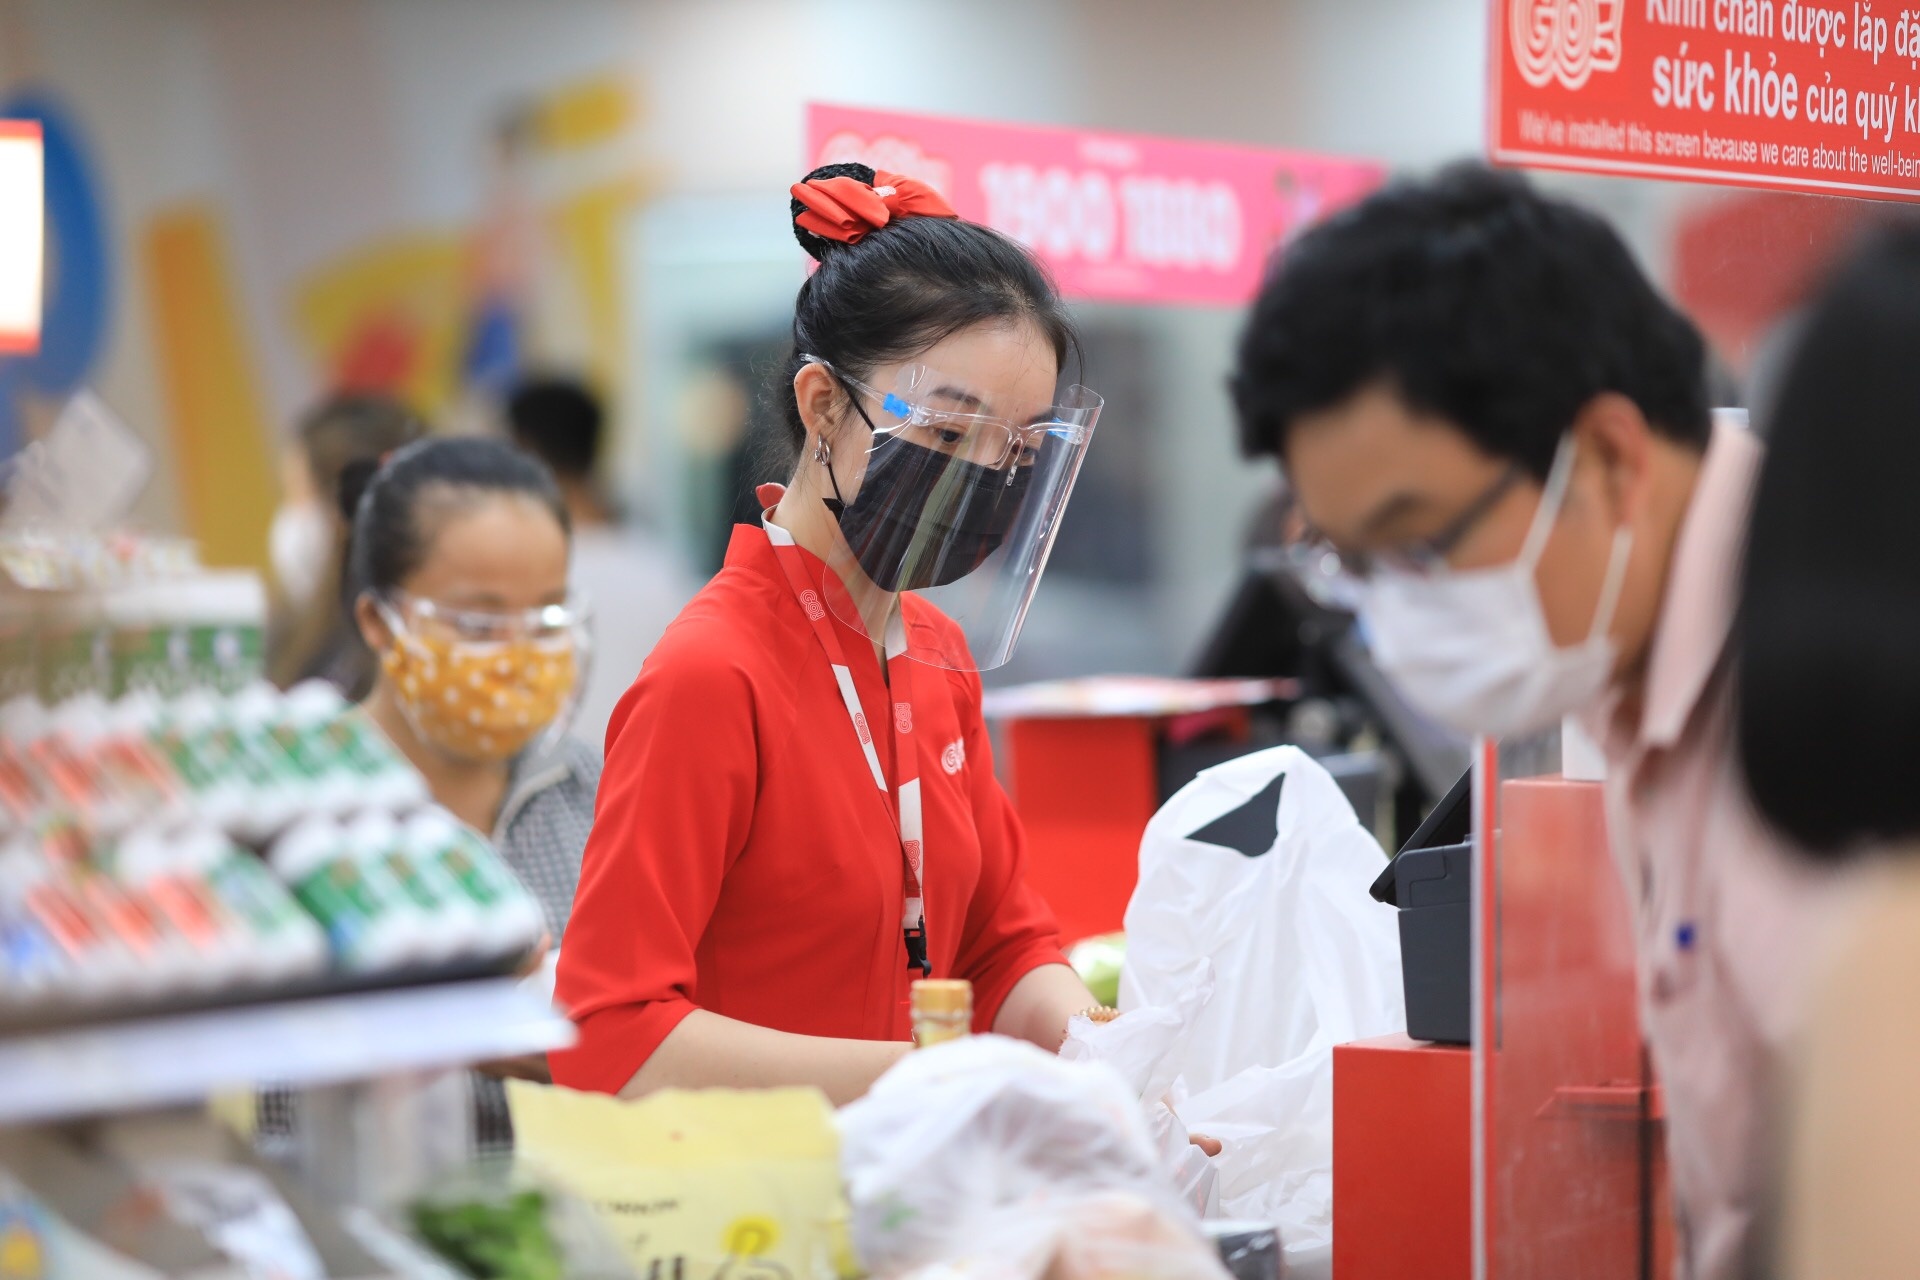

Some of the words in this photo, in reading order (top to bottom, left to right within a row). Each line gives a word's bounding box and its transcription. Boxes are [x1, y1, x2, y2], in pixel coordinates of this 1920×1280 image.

[1781, 0, 1846, 58] được
[1652, 41, 1715, 111] sức
[1724, 49, 1799, 121] khỏe
[1806, 71, 1848, 125] của
[1855, 82, 1898, 143] quý
[1517, 109, 1565, 146] We've
[1568, 116, 1626, 152] installed
[1628, 121, 1653, 154] this
[1655, 131, 1700, 157] screen
[1703, 130, 1757, 163] because
[1761, 142, 1779, 165] we
[1782, 144, 1809, 167] care
[1812, 142, 1847, 171] about
[1850, 147, 1868, 173] the
